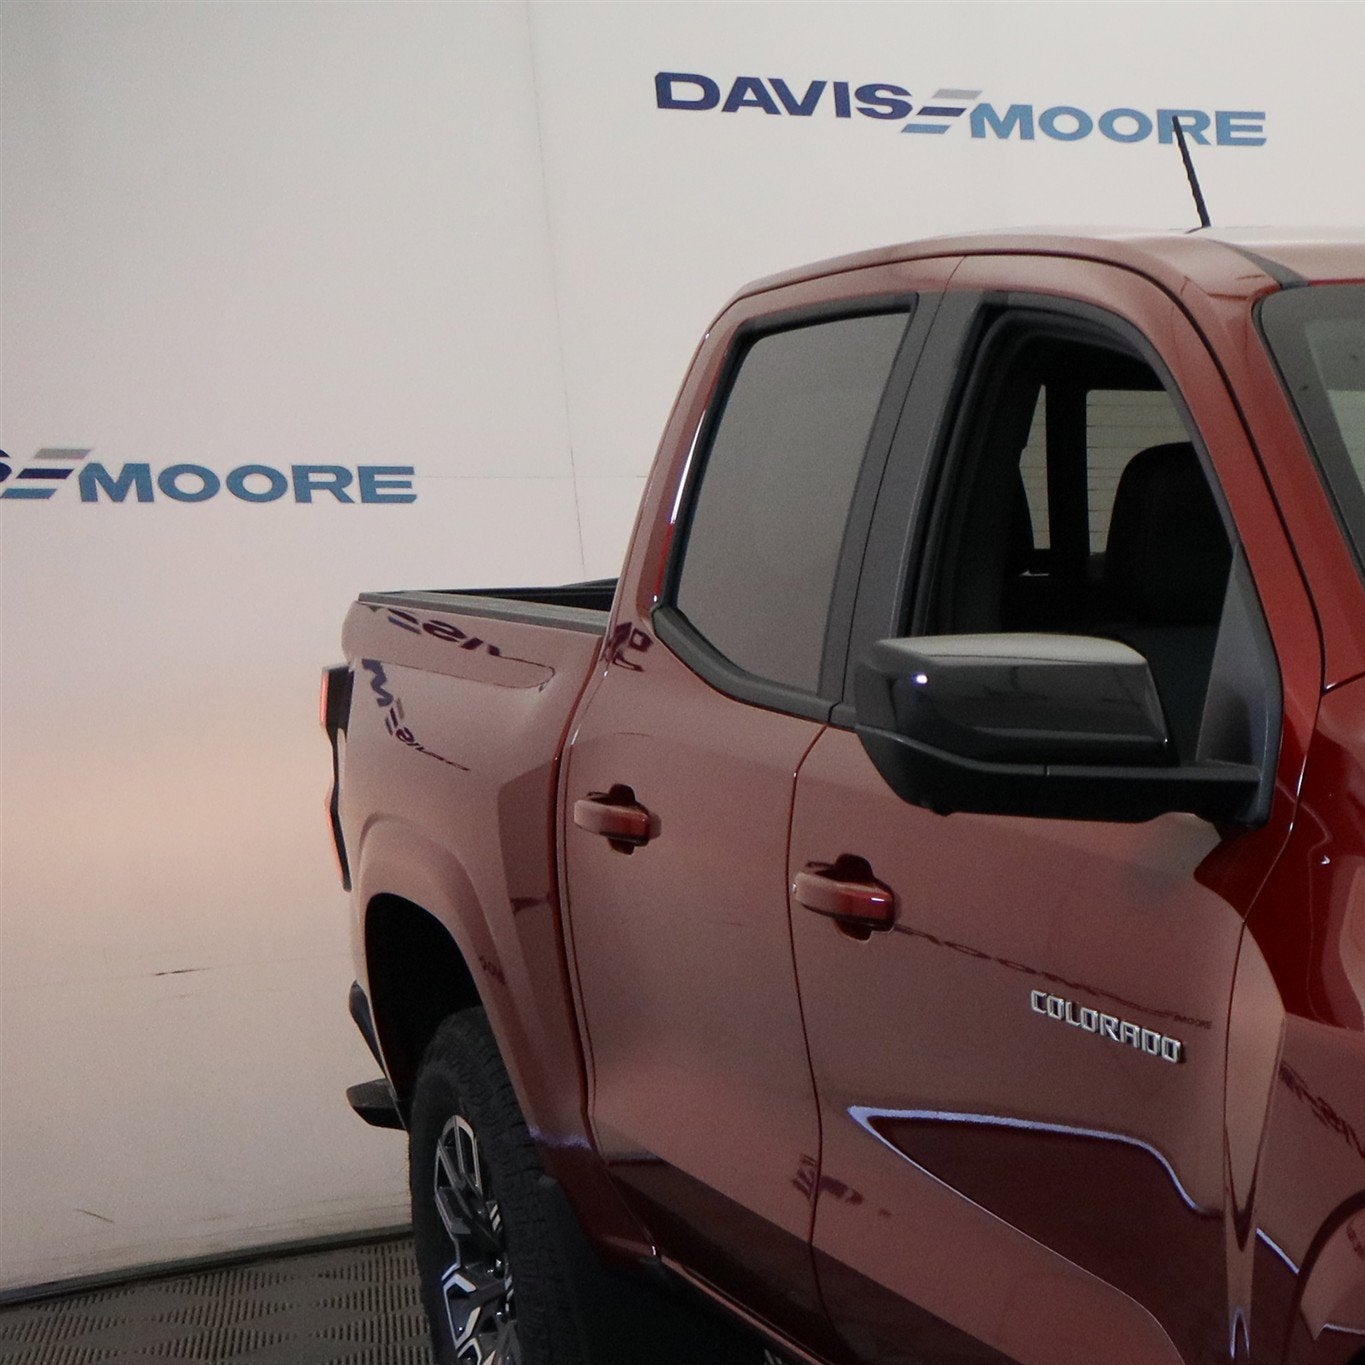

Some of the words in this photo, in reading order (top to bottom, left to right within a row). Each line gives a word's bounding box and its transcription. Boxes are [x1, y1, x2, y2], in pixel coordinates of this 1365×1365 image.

[655, 71, 912, 120] DAVIS
[969, 103, 1267, 146] MOORE
[78, 462, 417, 503] MOORE
[1030, 989, 1183, 1064] COLORADO
